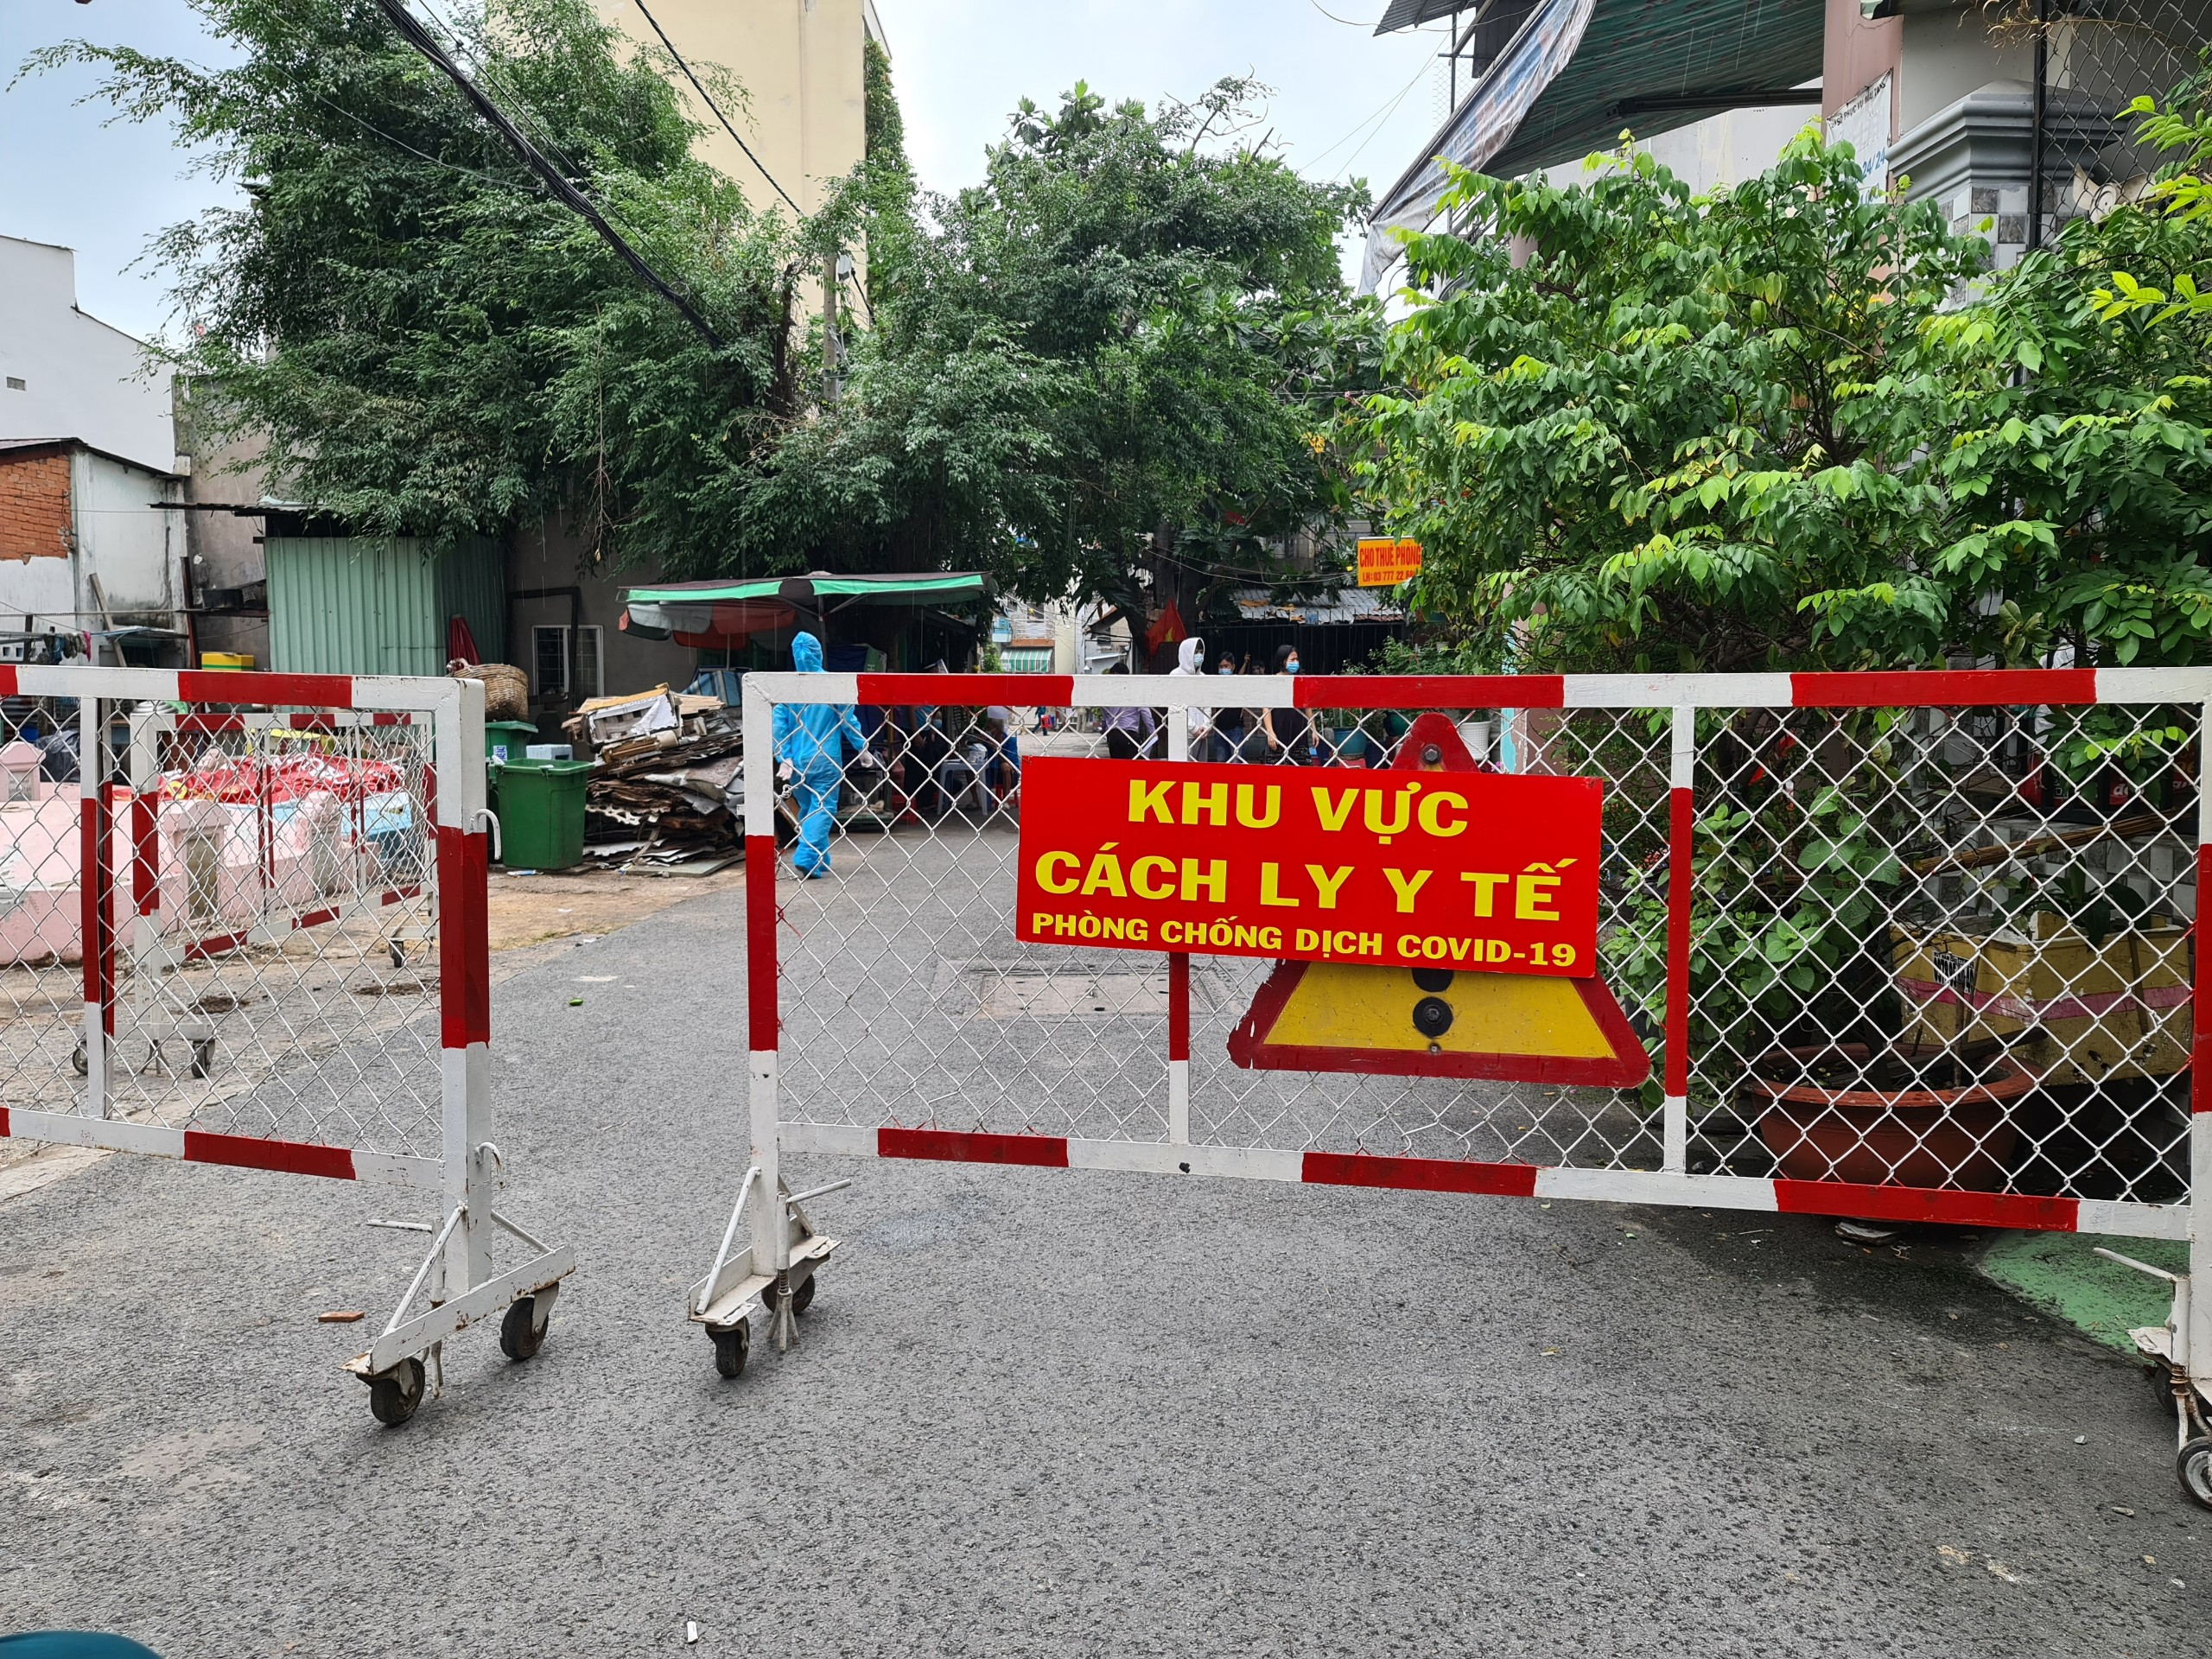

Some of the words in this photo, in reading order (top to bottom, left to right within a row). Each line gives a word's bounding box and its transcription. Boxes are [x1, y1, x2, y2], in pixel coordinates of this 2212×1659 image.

[1359, 548, 1375, 568] CHO
[1376, 543, 1395, 567] THUÊ
[1395, 543, 1421, 566] PHÒNG
[1383, 571, 1395, 581] 777
[1395, 570, 1404, 581] 22
[1128, 779, 1281, 829] KHU
[1311, 781, 1469, 845] VỰC
[1035, 842, 1227, 903] CÁCH
[1260, 861, 1355, 909] LY
[1382, 868, 1433, 913] Y
[1461, 858, 1579, 921] TẾ
[1033, 910, 1148, 942] PHÒNG
[1160, 916, 1282, 950] CHỐNG
[1295, 928, 1382, 958] DỊCH
[1396, 934, 1576, 967] COVID-19
